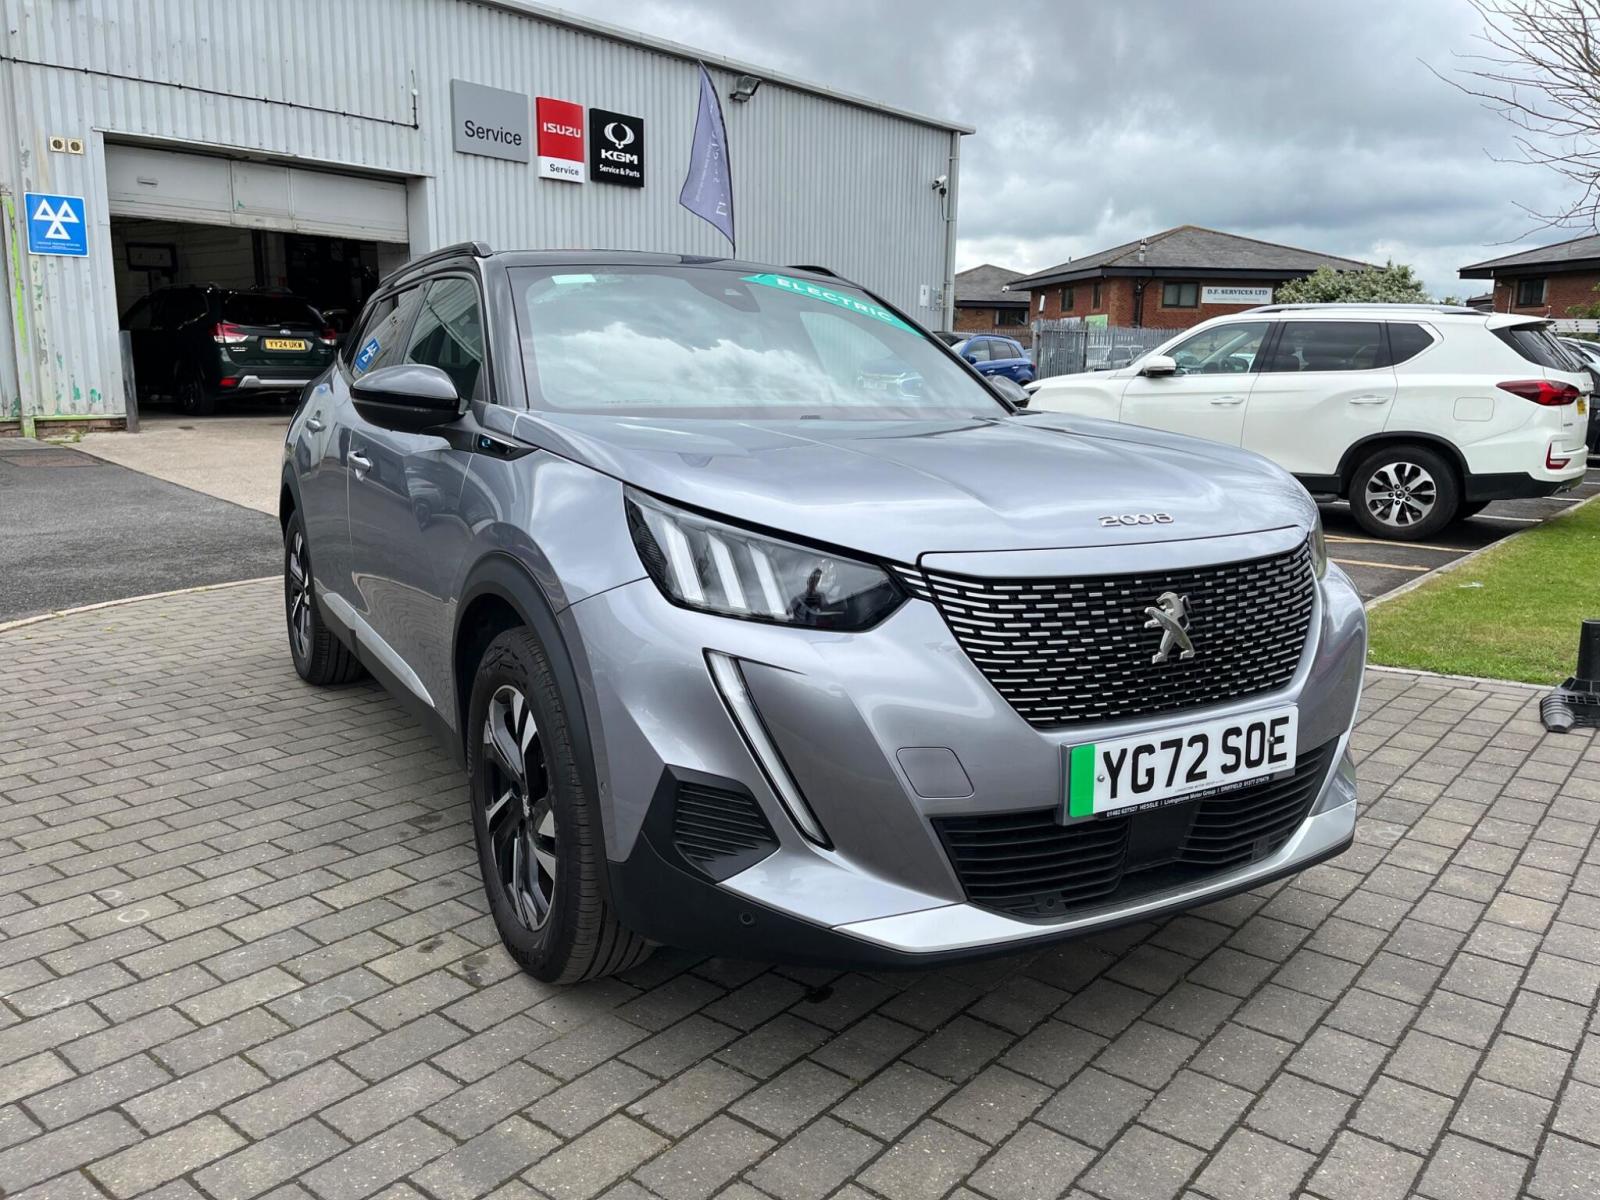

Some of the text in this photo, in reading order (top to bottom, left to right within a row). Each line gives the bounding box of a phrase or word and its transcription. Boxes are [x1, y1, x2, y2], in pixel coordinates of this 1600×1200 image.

[464, 119, 522, 146] Service
[543, 121, 581, 138] ISUZU
[601, 148, 638, 165] KGM
[549, 163, 580, 176] Service
[599, 163, 640, 178] Service & Parts
[776, 277, 893, 322] ELECTRIC
[269, 339, 287, 348] YY24
[1098, 512, 1174, 528] 2008
[1103, 716, 1290, 799] YG72 SOE
[1140, 800, 1159, 811] HESSLE
[1189, 791, 1202, 800] Motor
[1202, 788, 1217, 797] Group
